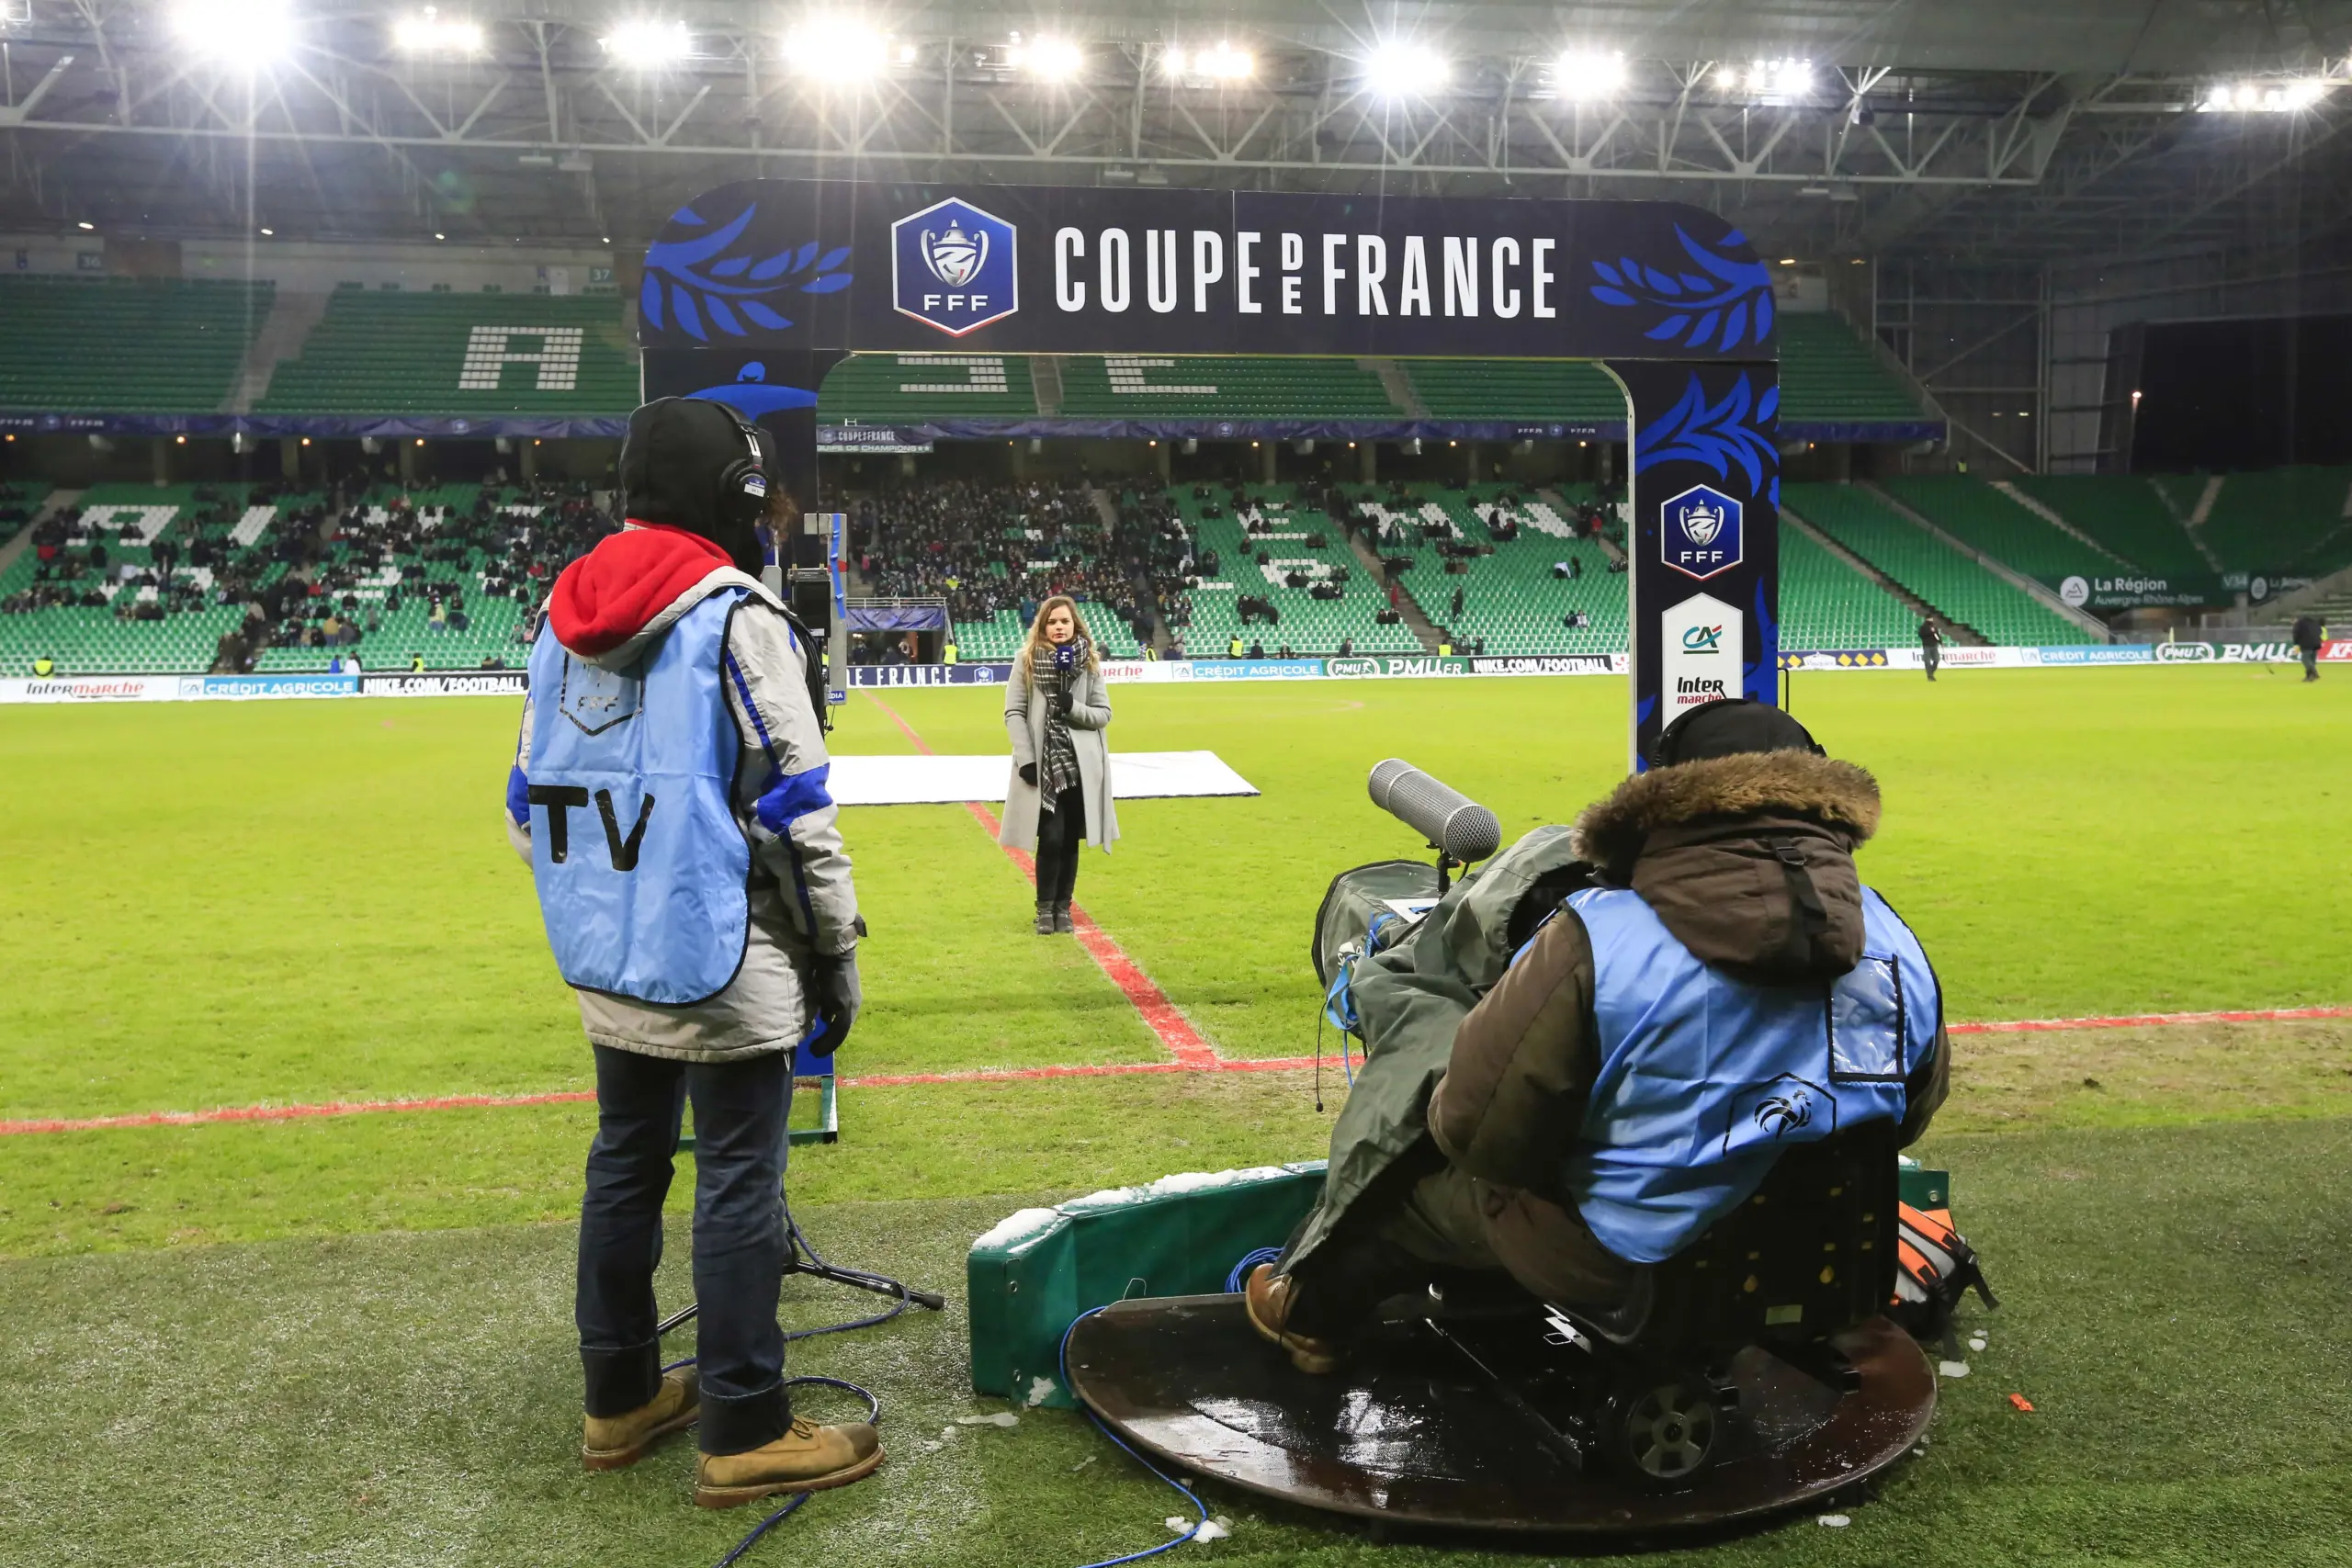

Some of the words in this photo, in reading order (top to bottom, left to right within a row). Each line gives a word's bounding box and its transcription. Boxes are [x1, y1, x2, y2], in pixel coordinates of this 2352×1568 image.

[1055, 227, 1262, 314] COUPE
[1324, 233, 1556, 319] FRANCE
[923, 294, 989, 312] FFF
[838, 431, 863, 441] COUPE
[867, 431, 895, 441] FRANCE
[1680, 551, 1724, 563] FFF
[2095, 579, 2113, 591] La
[2115, 578, 2167, 592] Région
[2089, 649, 2151, 660] AGRICOLE
[1195, 665, 1245, 676] CRÉDIT
[1249, 665, 1318, 675] AGRICOLE
[1334, 663, 1362, 674] PMU
[1473, 658, 1607, 673] NIKE.COM/FOOTBALL
[876, 666, 952, 685] FRANCE
[270, 681, 354, 694] AGRICOLE
[363, 676, 524, 694] NIKE.COM/FOOTBALL
[528, 784, 655, 872] TV
